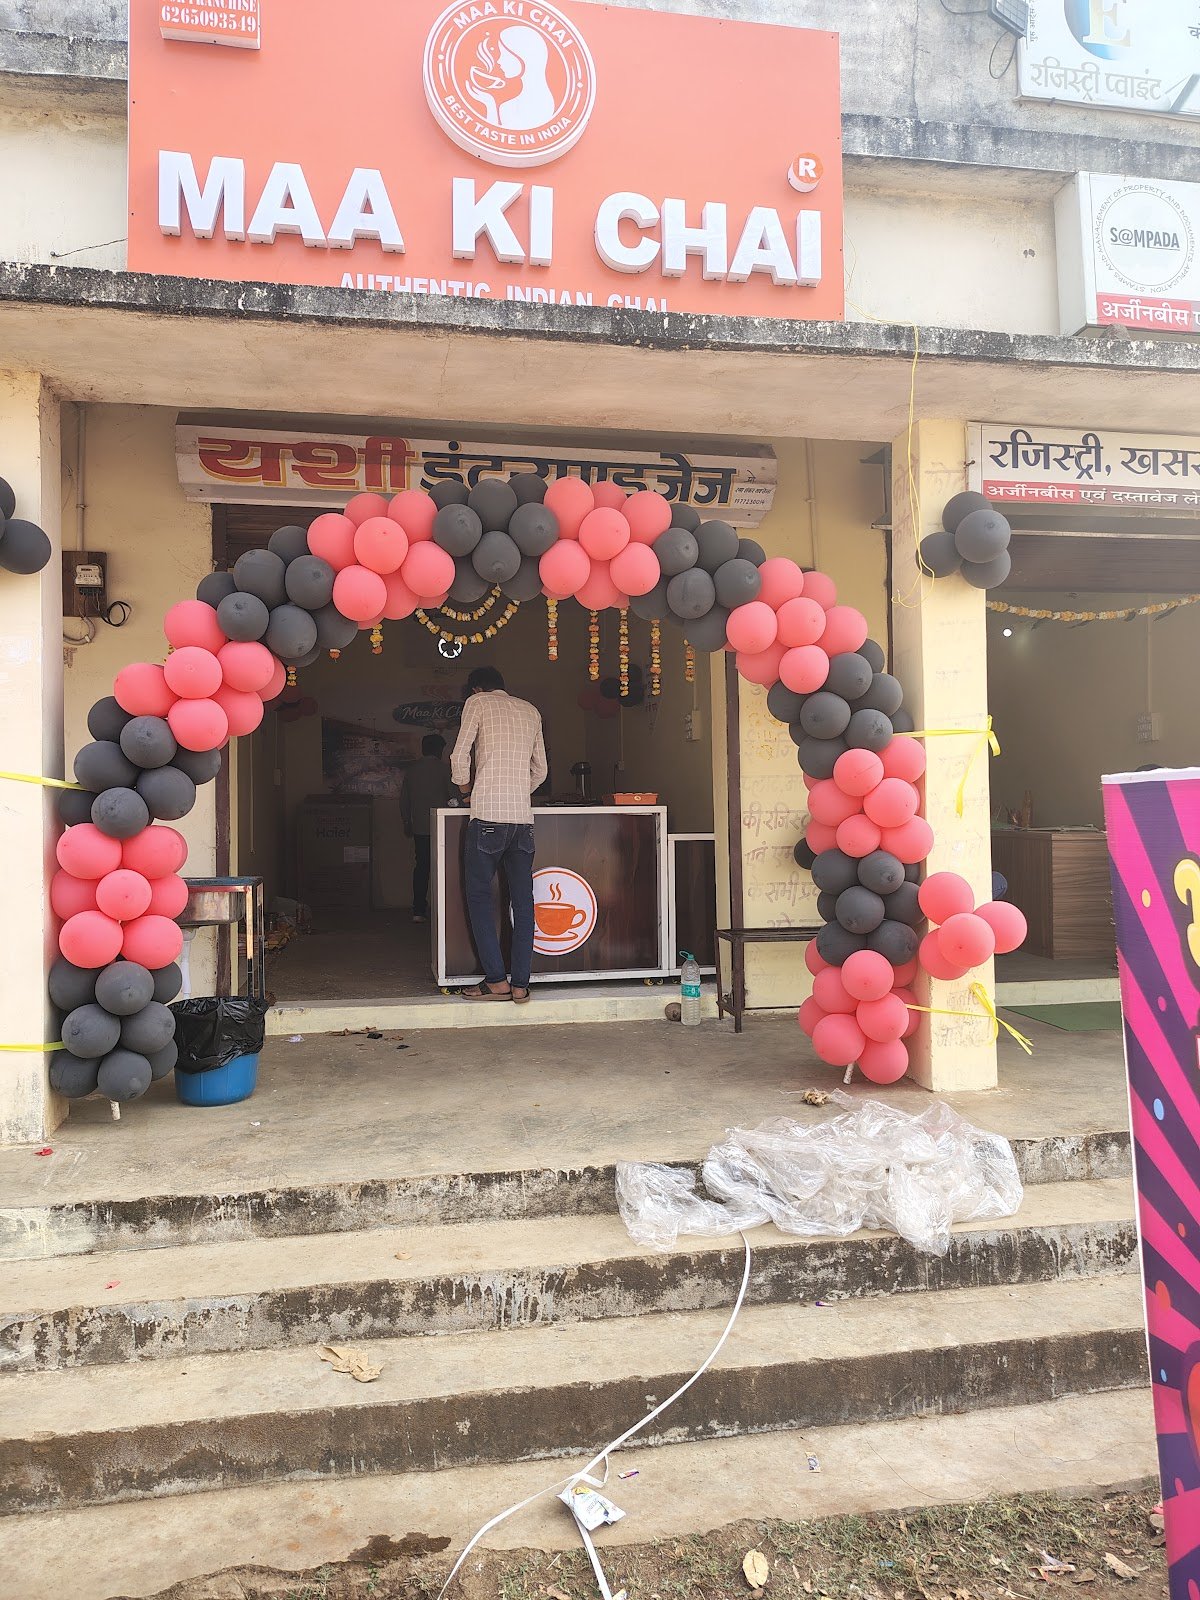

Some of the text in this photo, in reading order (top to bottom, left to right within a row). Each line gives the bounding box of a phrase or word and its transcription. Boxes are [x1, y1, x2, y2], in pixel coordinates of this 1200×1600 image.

[161, 5, 256, 32] 6265093549
[453, 0, 573, 48] MAA KI CHAI
[1030, 56, 1162, 101] रजिस्ट्री प्वाइंट
[444, 95, 572, 145] BEST TASTE IN INDIA
[798, 157, 817, 178] R
[159, 149, 822, 288] MAA KI CHAI
[1094, 195, 1113, 254] MANAGEMENT
[1113, 188, 1123, 198] OF
[1123, 184, 1166, 198] PROPERTY
[1165, 194, 1180, 210] AND
[1110, 227, 1180, 249] S@MPADA
[340, 272, 667, 312] AUTHENTIC INDIAN CHAI
[198, 436, 419, 491] यशी
[1080, 488, 1106, 504] एवं
[1110, 490, 1179, 504] दस्तावेज
